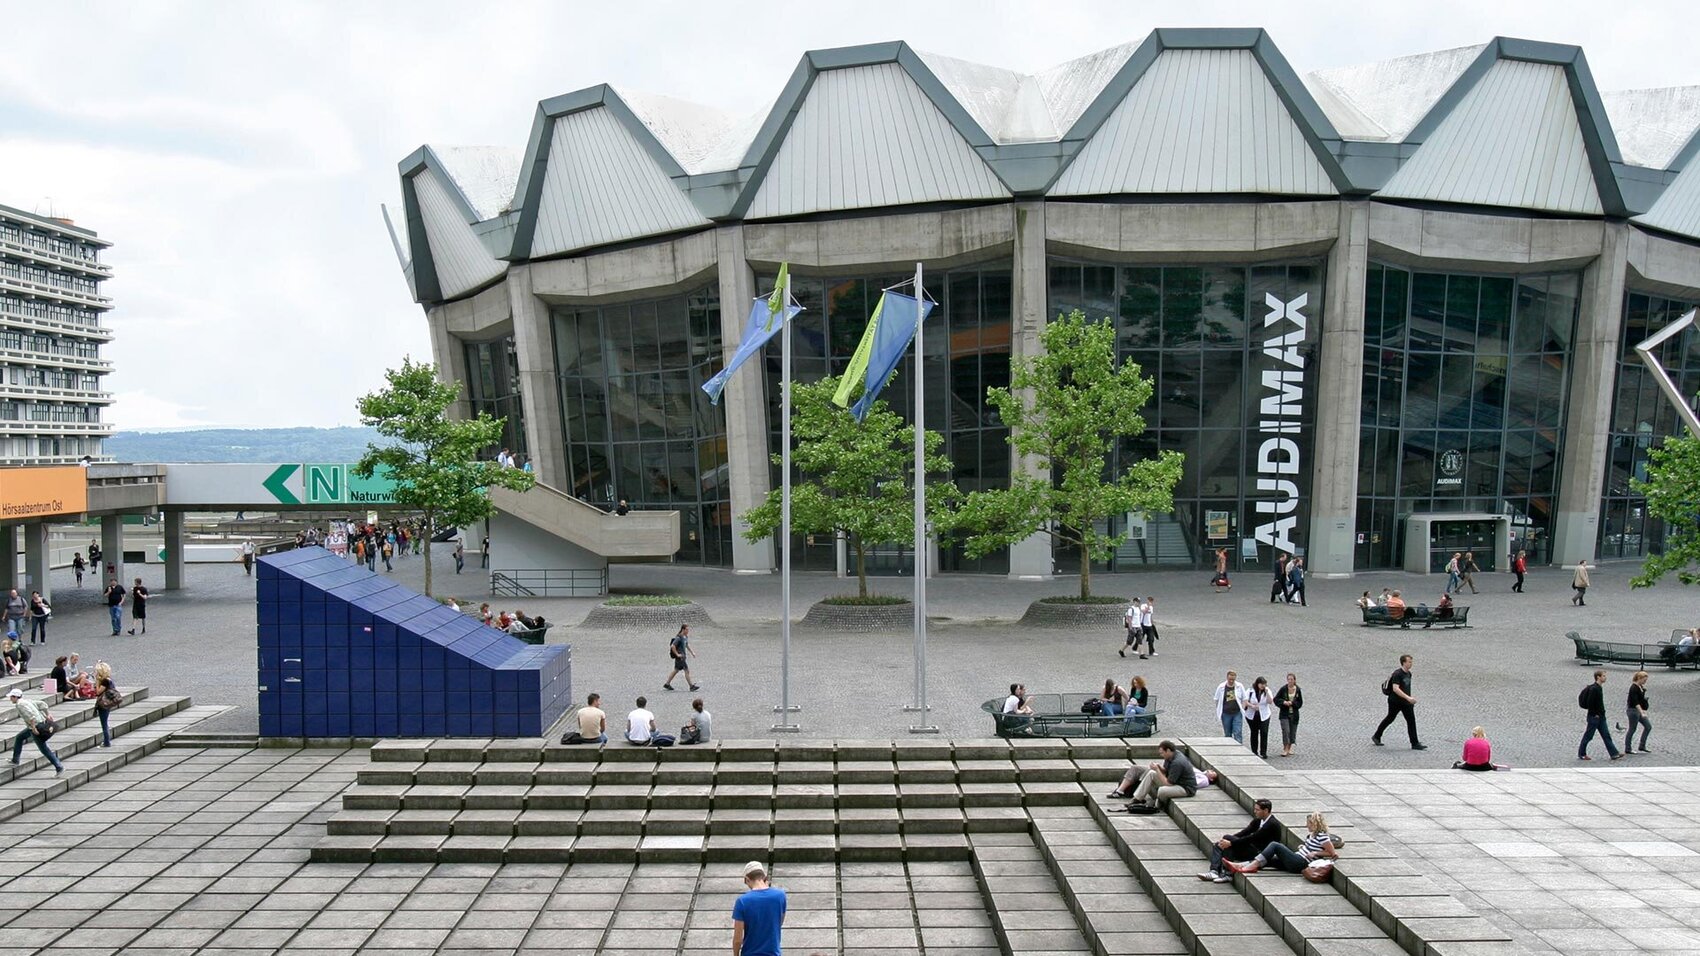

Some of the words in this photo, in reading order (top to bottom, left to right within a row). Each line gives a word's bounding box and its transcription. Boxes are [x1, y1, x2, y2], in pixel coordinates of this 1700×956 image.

[1255, 292, 1308, 555] AUDIMAX
[310, 466, 340, 502] N
[2, 501, 51, 515] Hörsaalzentrum
[52, 499, 63, 511] Ost
